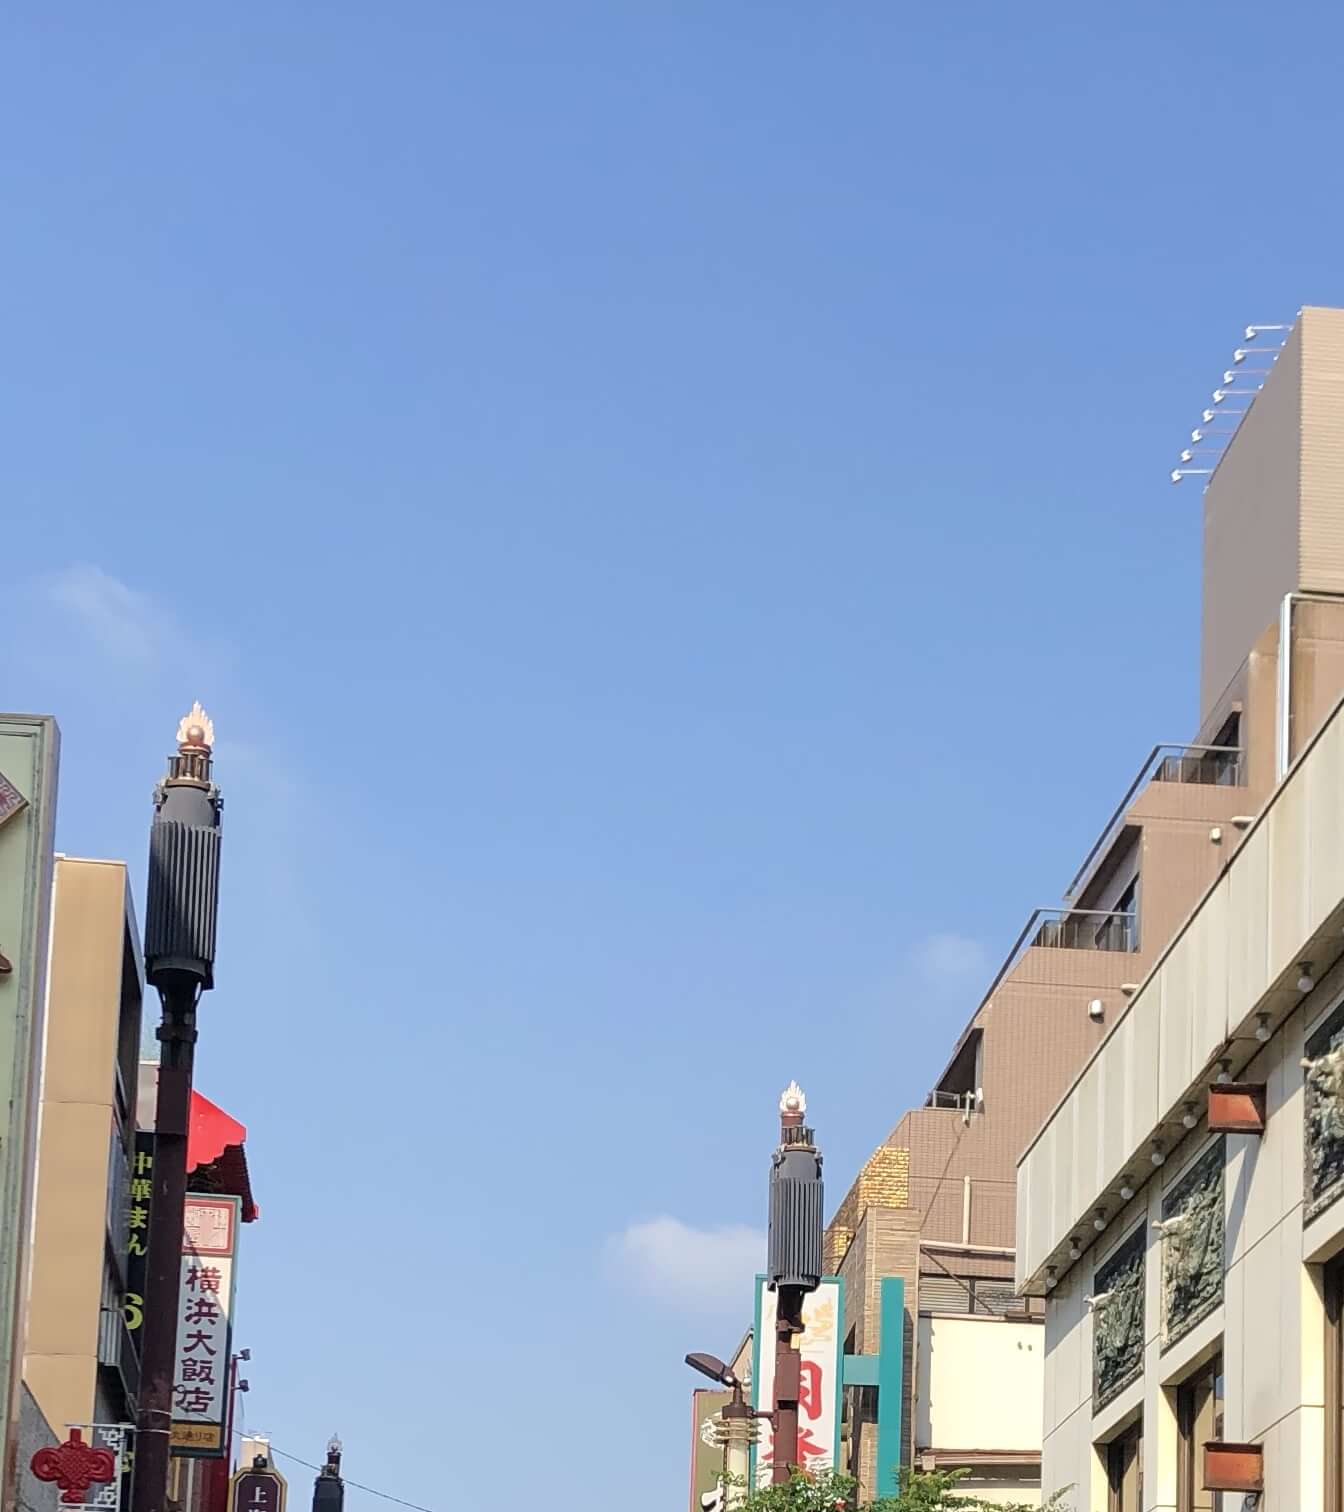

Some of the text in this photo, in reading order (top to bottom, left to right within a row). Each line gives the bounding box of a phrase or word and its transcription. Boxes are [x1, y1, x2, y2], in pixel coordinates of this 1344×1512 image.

[175, 1265, 223, 1414] 横浜大飯店
